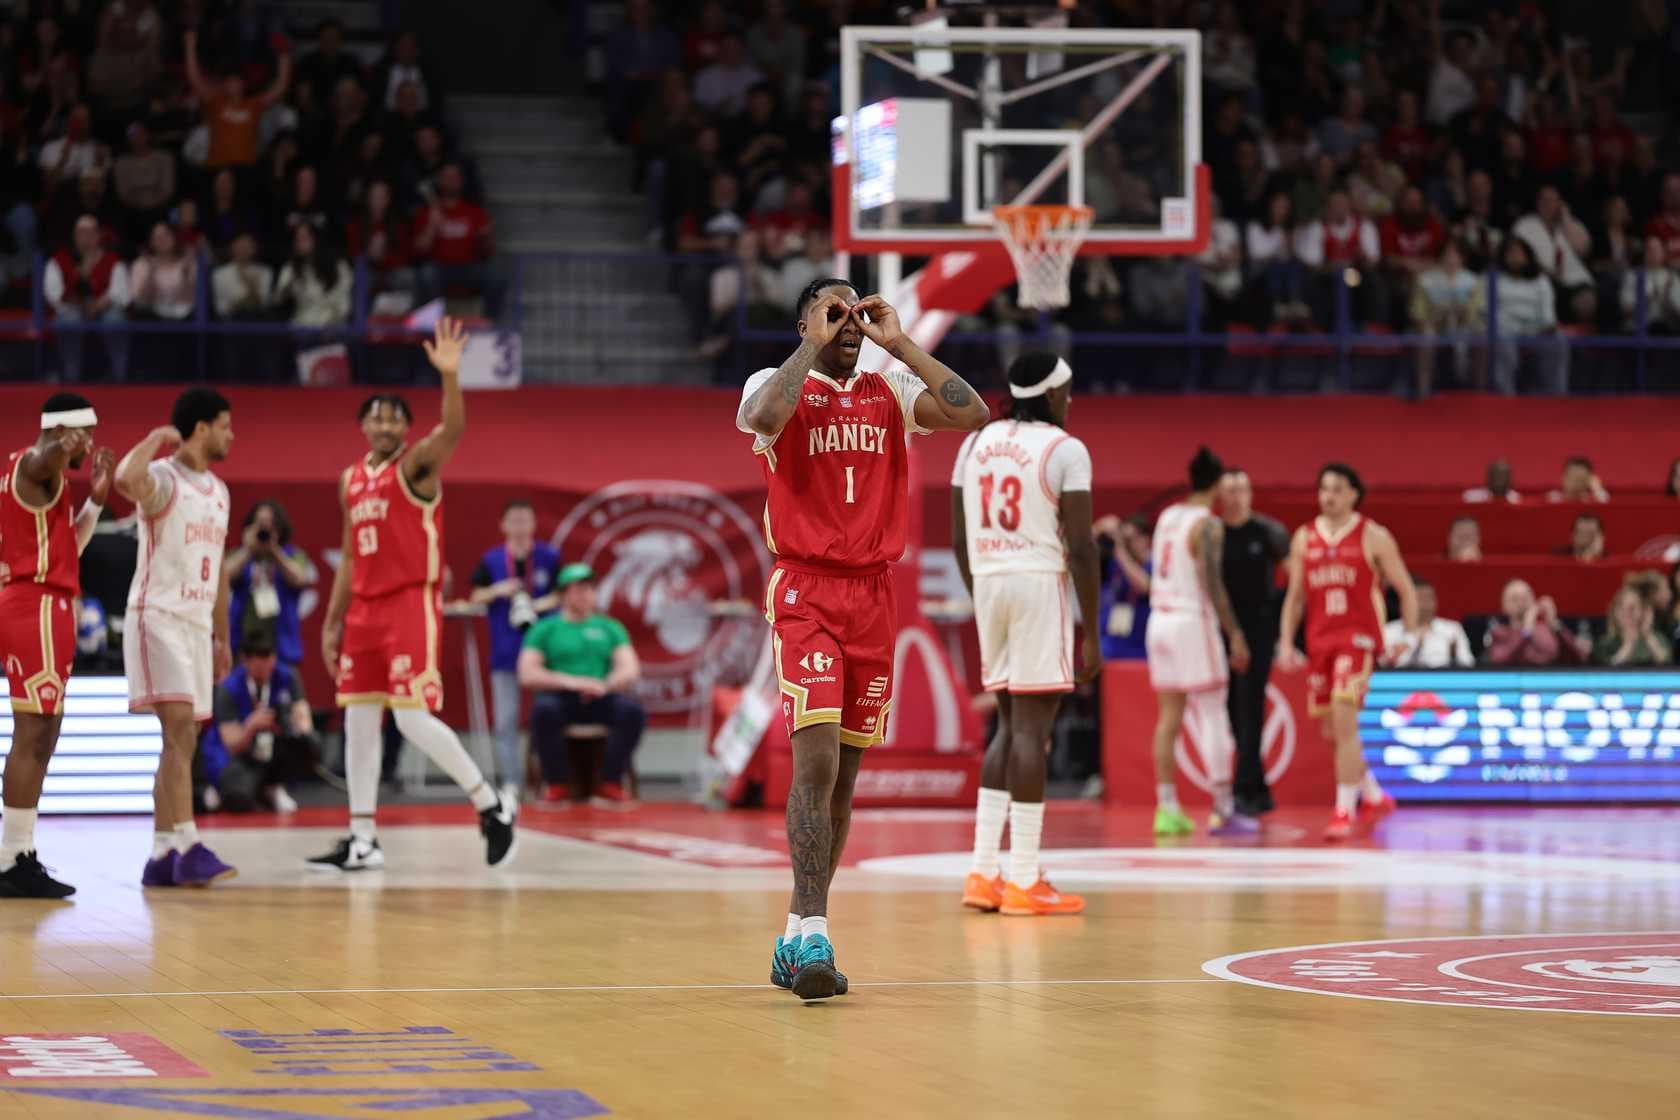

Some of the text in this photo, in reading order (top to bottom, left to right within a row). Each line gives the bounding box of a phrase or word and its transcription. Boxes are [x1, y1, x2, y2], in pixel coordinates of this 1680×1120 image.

[830, 415, 868, 423] GRAND
[808, 423, 888, 456] NANCY
[844, 466, 856, 503] 1
[978, 472, 1023, 533] 13
